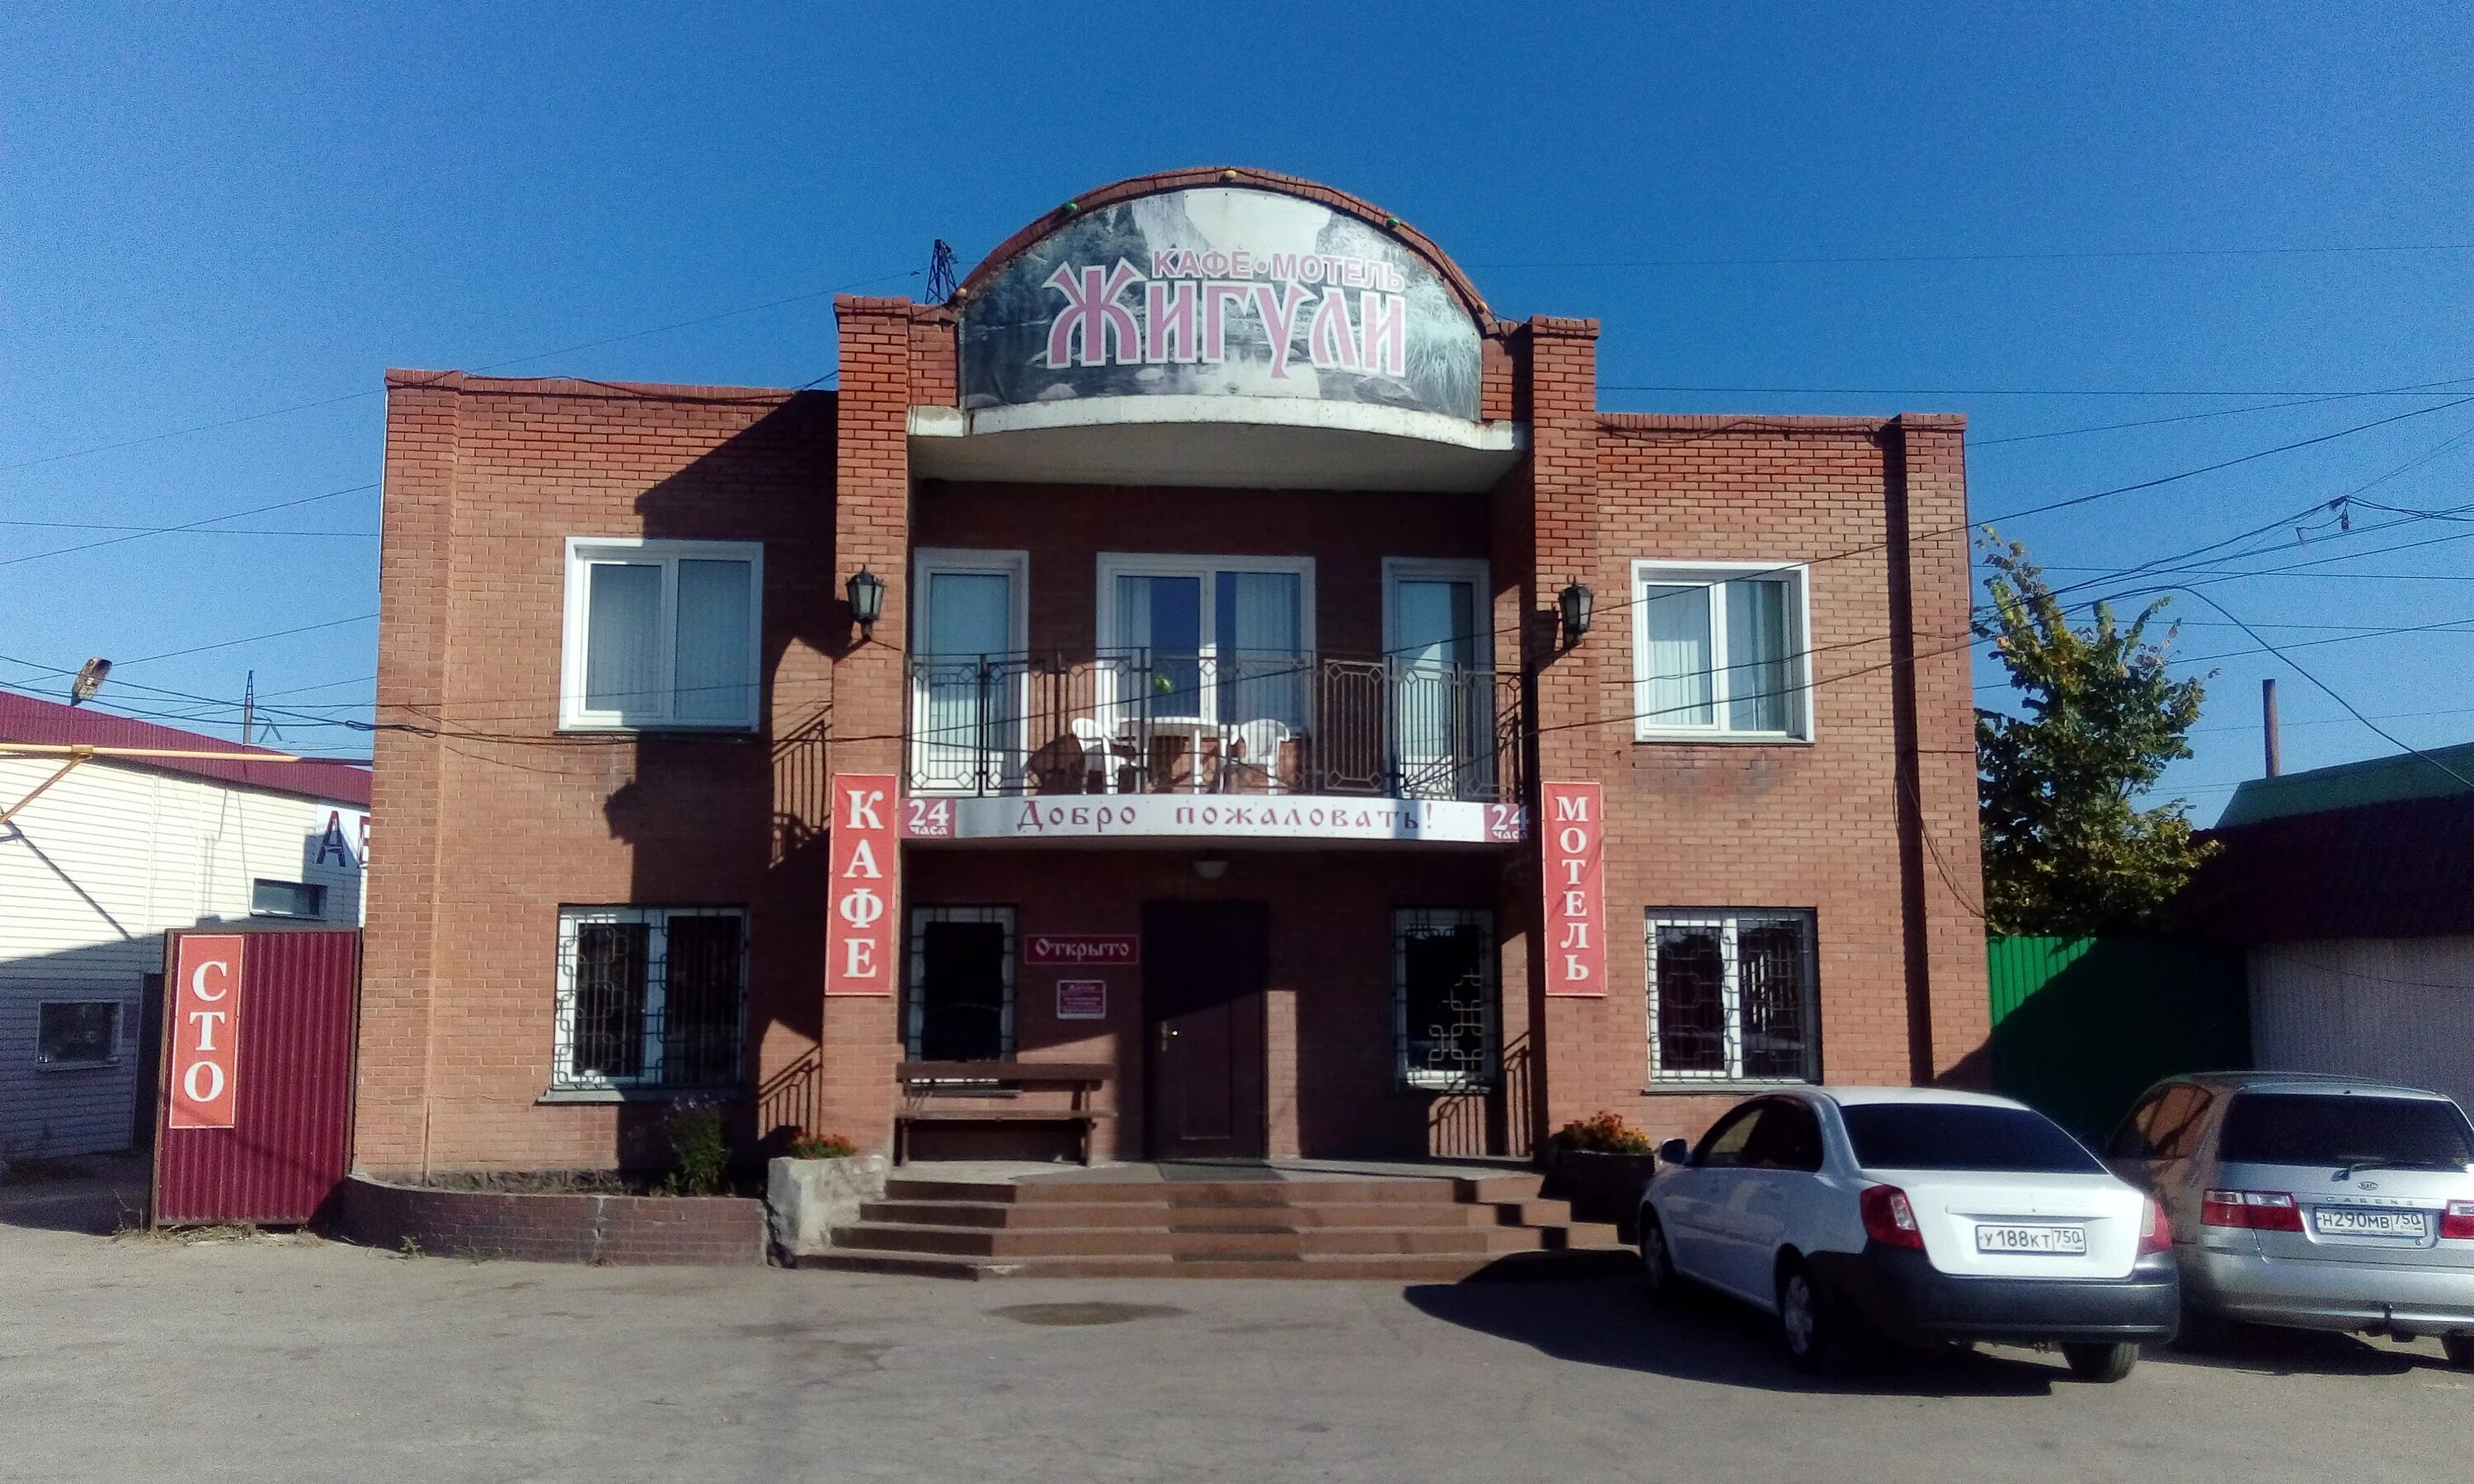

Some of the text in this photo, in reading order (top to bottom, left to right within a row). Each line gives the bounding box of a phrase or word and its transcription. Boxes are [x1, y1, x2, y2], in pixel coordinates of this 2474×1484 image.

[1042, 257, 1406, 378] ЖИГУЛИ
[908, 799, 951, 826] 24
[1016, 801, 1433, 833] Добро пожаловать!
[1491, 804, 1529, 831] 24
[839, 789, 884, 979] КАФЕ
[1554, 795, 1591, 982] МОТЕЛЬ
[1035, 937, 1129, 963] Открыто
[184, 960, 228, 1102] СТО
